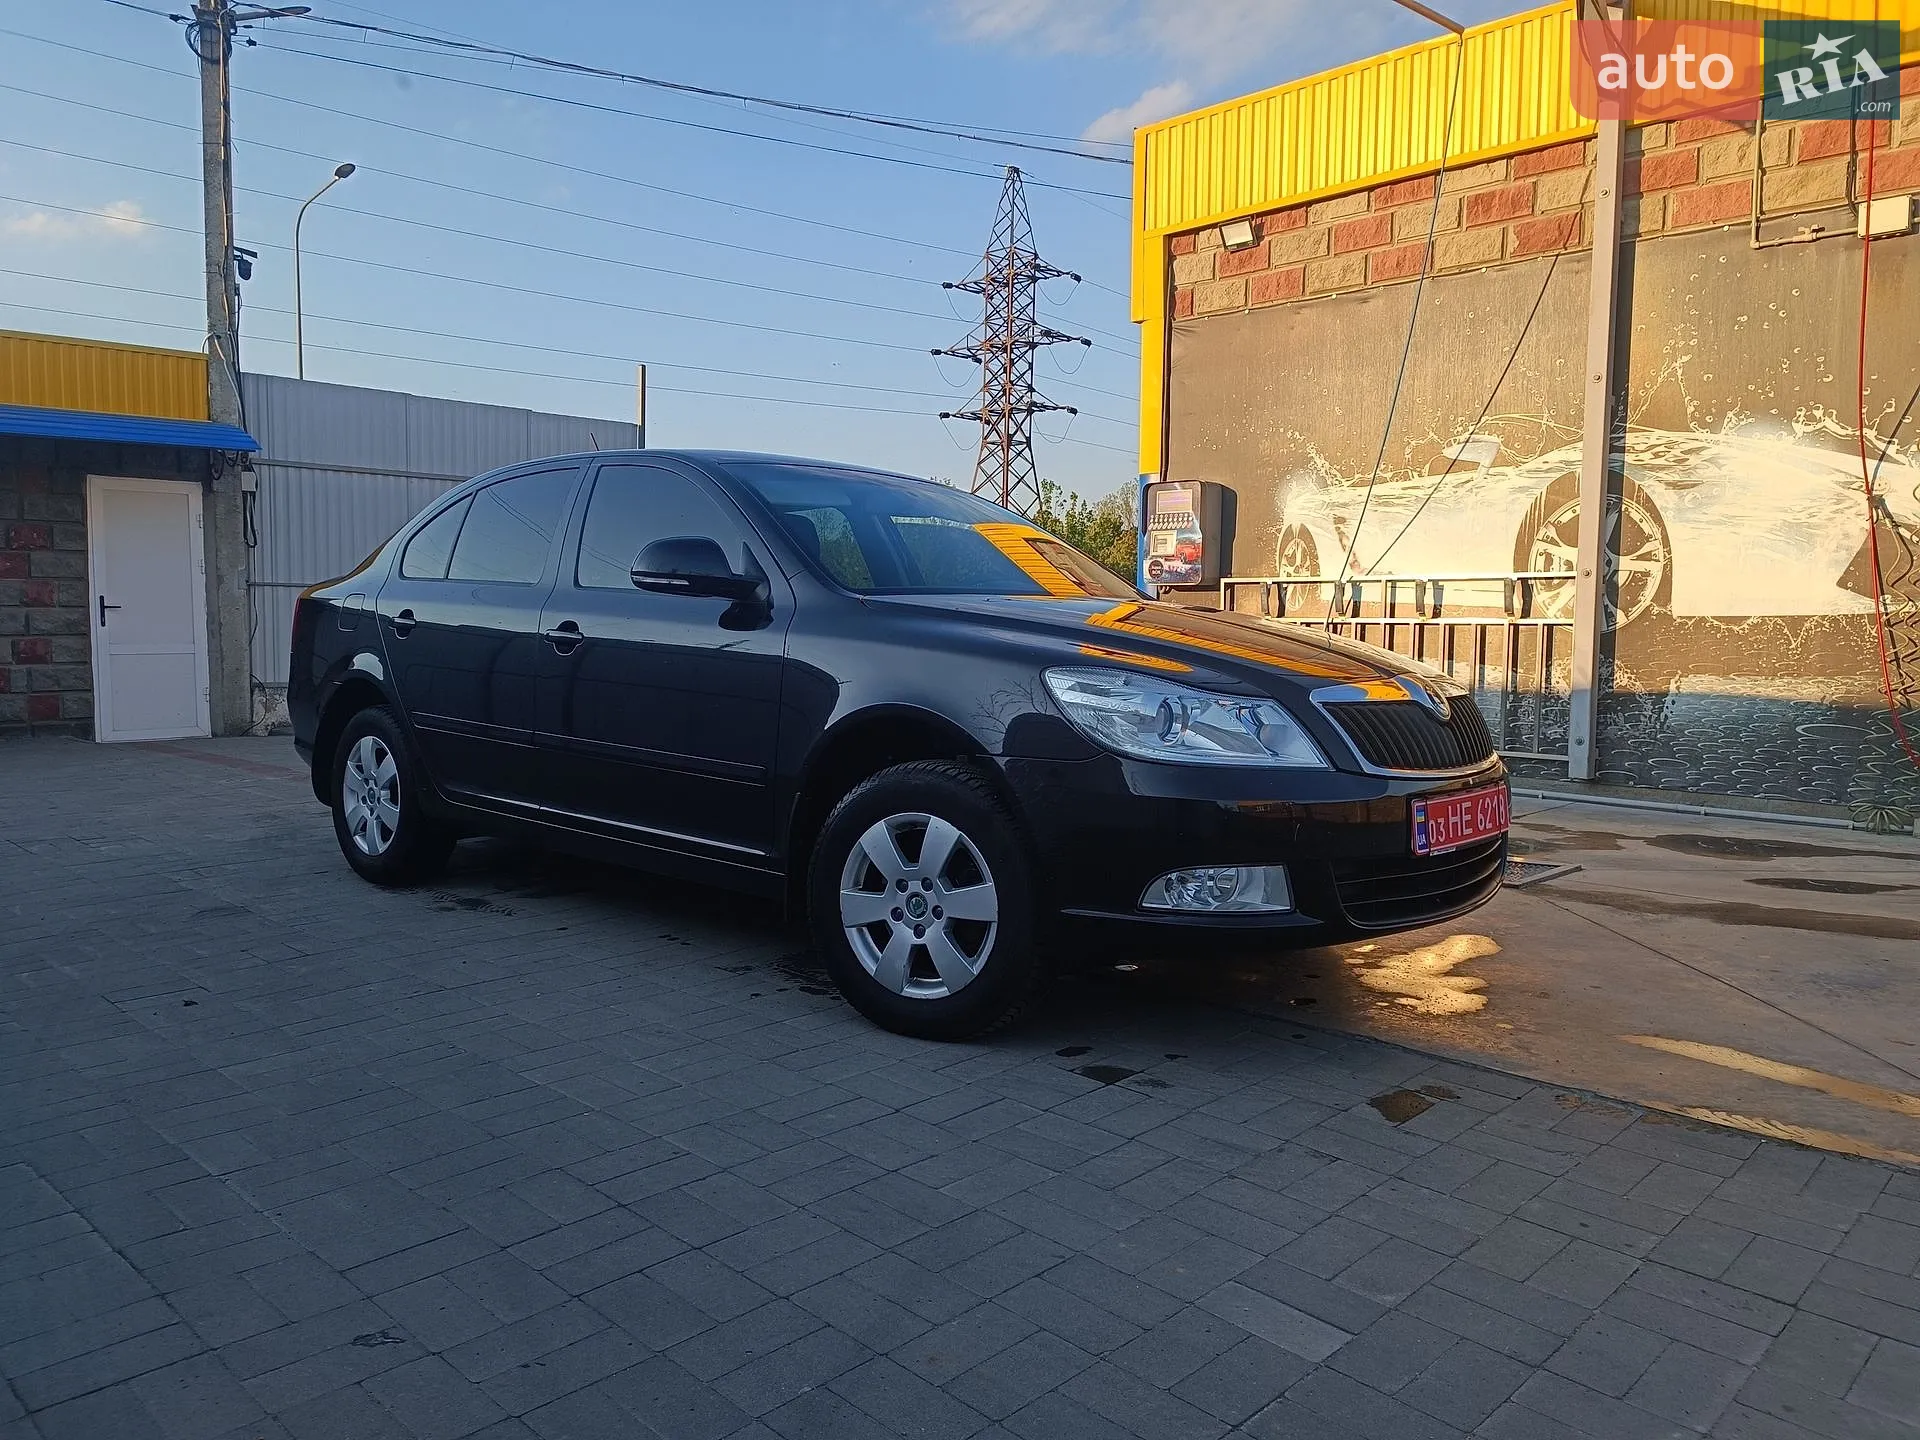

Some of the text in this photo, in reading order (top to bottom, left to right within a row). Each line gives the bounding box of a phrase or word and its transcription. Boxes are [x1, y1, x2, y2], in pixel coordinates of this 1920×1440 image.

[1429, 794, 1506, 844] 03 HE 6218
[1417, 833, 1427, 846] UA
